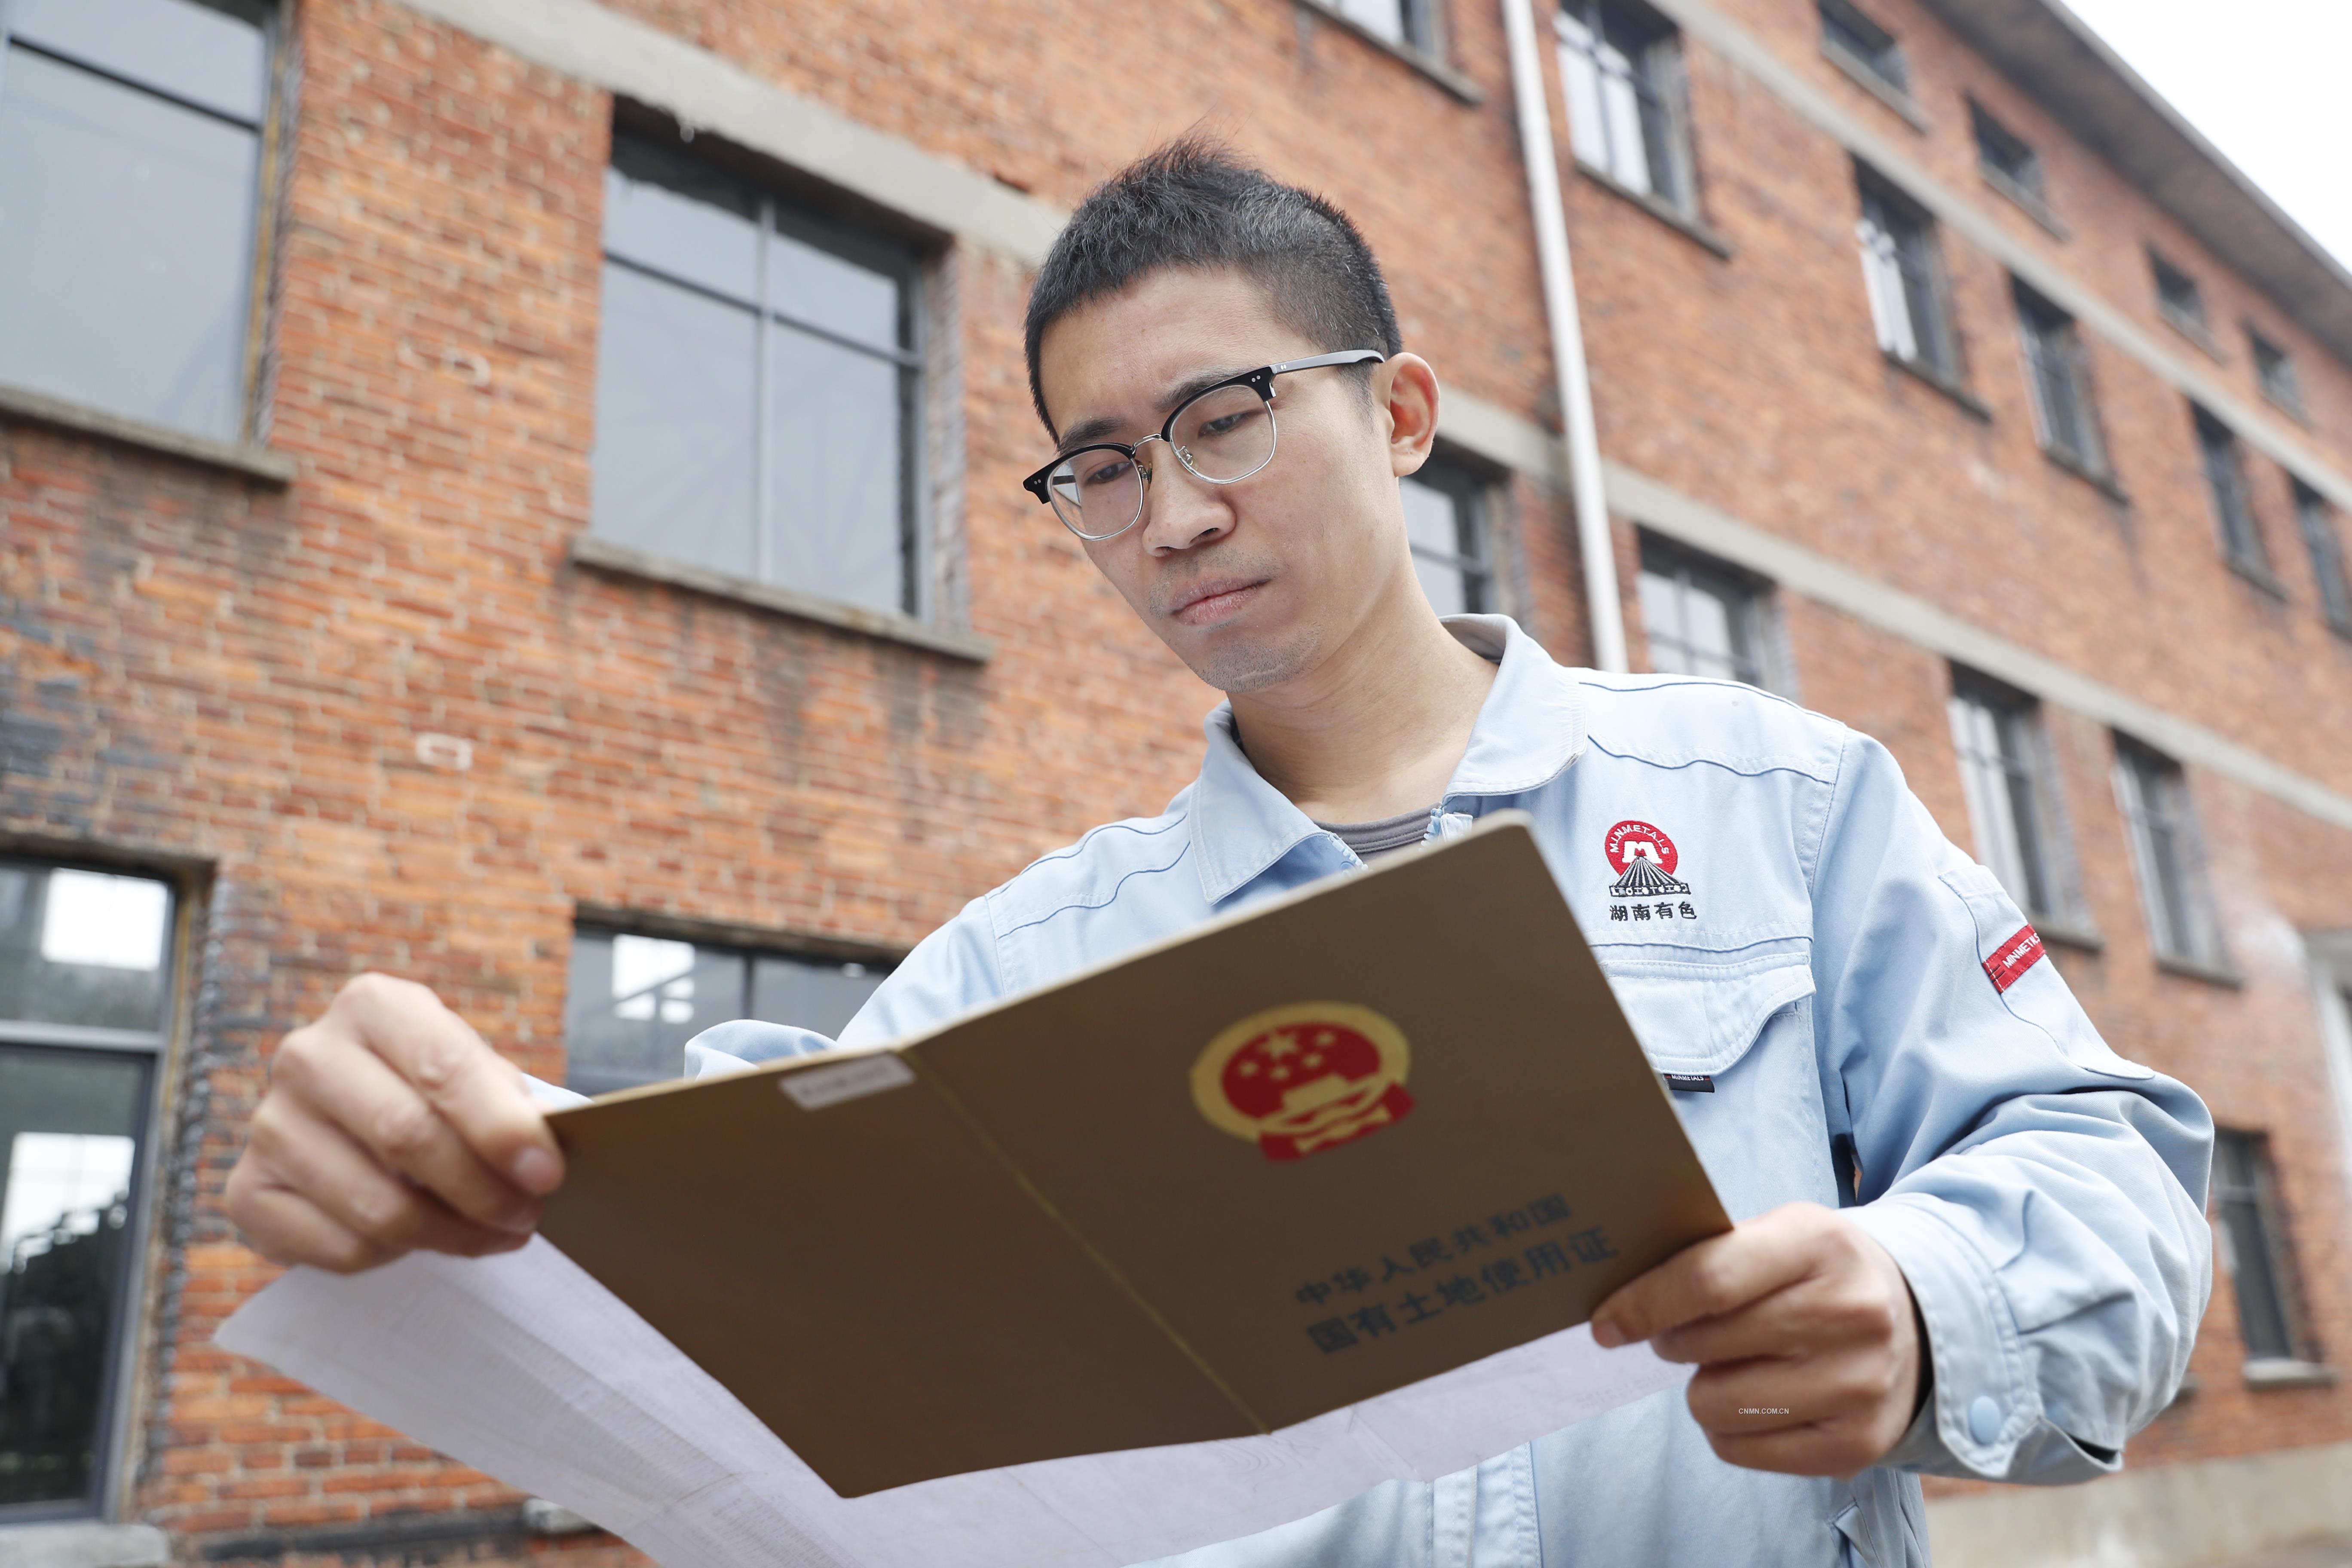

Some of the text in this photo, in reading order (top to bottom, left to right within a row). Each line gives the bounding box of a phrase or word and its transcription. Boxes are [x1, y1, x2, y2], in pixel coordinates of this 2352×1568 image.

[1609, 824, 1670, 854] MINMETALS
[1609, 901, 1697, 921] 湖南有色
[1295, 1193, 1571, 1304] 中华人民共和国
[1306, 1226, 1620, 1353] 国有土地使用证
